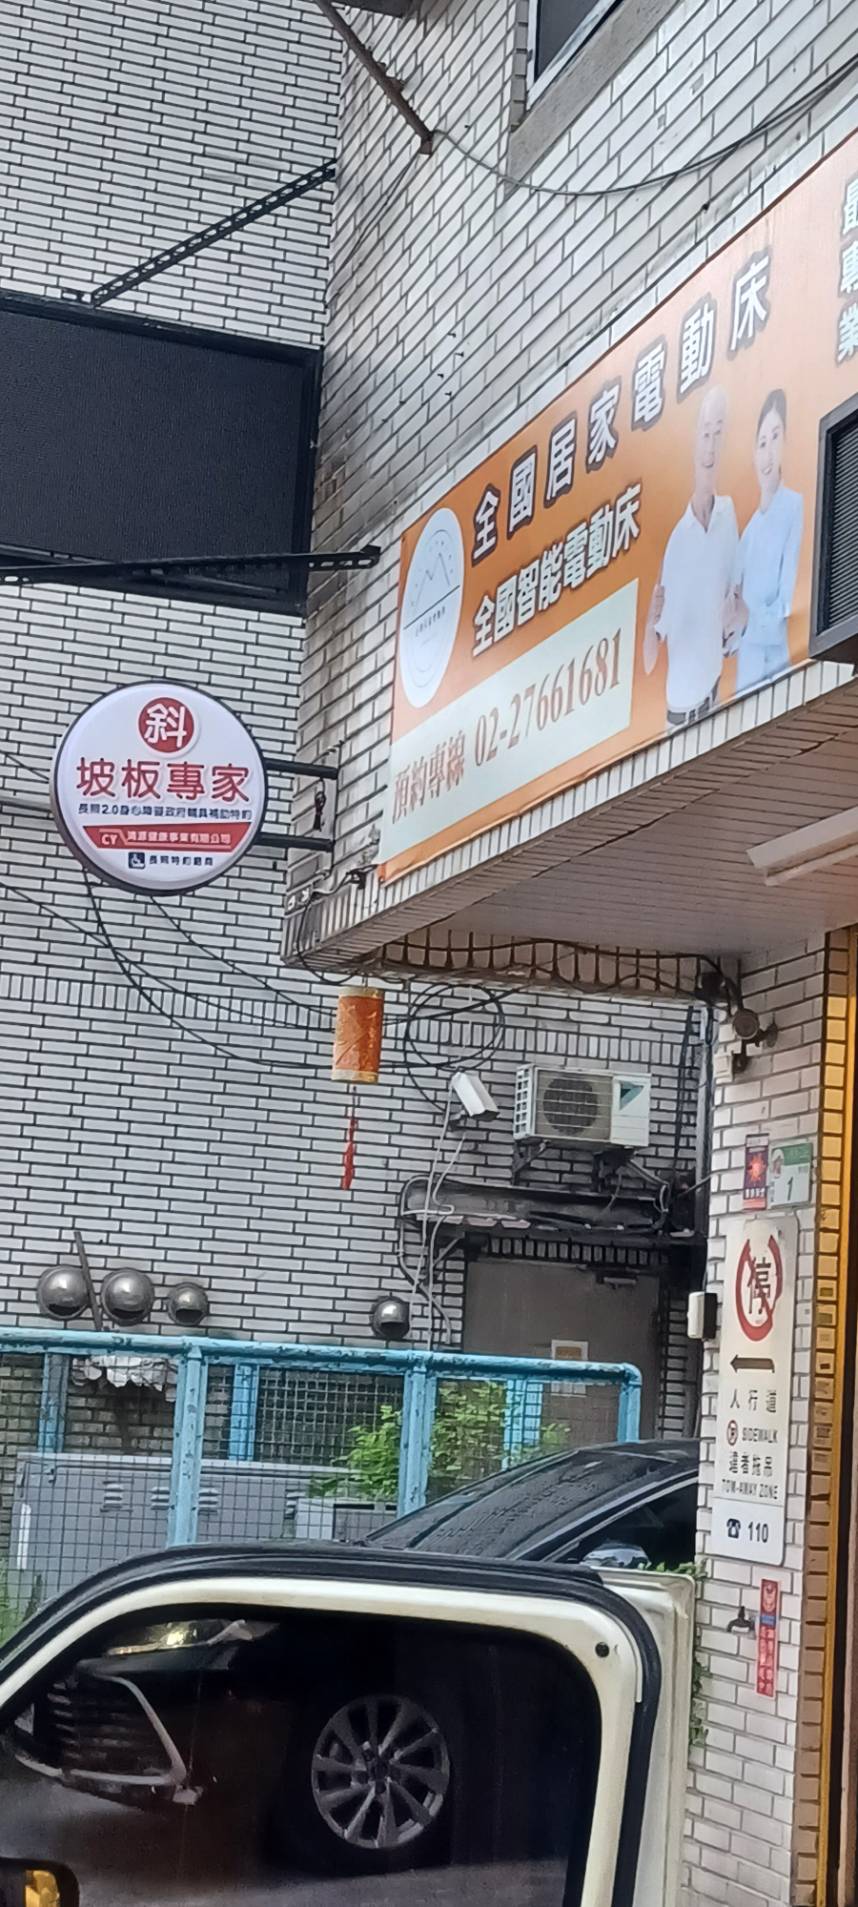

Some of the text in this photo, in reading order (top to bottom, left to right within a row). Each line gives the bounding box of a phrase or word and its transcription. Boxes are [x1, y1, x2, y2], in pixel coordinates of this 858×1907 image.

[472, 251, 772, 562] 全國居家電動床
[472, 483, 643, 658] 全國智能電動床
[143, 703, 188, 748] 斜
[392, 627, 622, 825] 預約專線 02-27661681
[76, 757, 251, 802] 坡板專家
[101, 833, 118, 846] CY
[786, 1176, 795, 1202] 1
[746, 1256, 772, 1315] 停
[729, 1388, 777, 1414] 人行道
[741, 1426, 779, 1445] SIDEWALK
[721, 1478, 779, 1500] TOW-AWAY ZONE
[748, 1520, 770, 1544] 110
